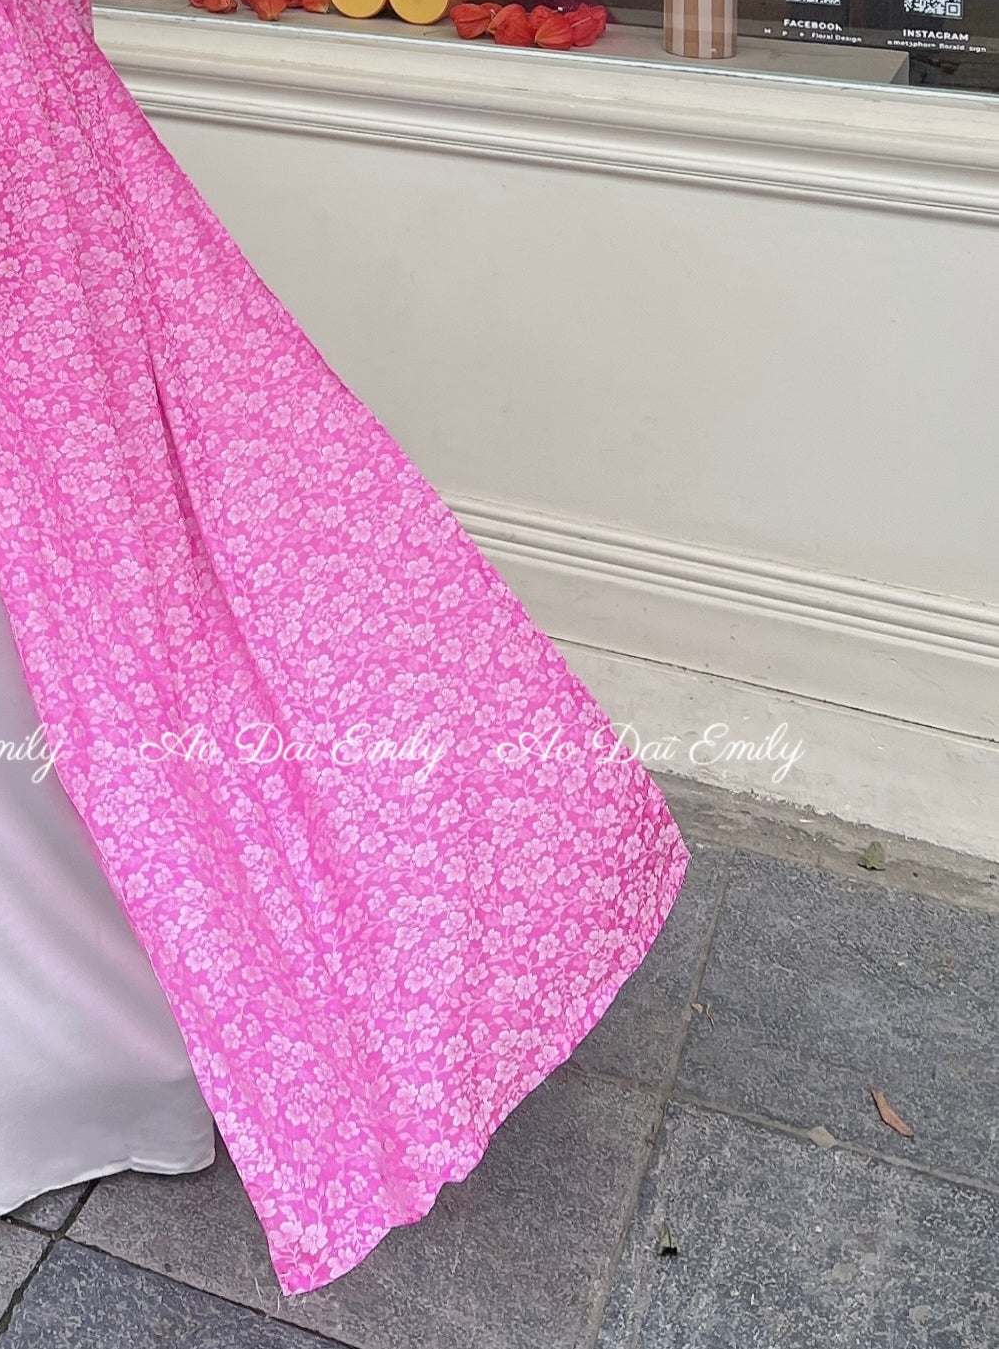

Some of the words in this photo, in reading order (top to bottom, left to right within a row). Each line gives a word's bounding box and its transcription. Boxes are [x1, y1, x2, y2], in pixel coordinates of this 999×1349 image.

[783, 18, 843, 32] FACEBOOK
[811, 32, 834, 40] Floral
[835, 34, 863, 44] Design
[902, 28, 969, 42] INSTAGRAM
